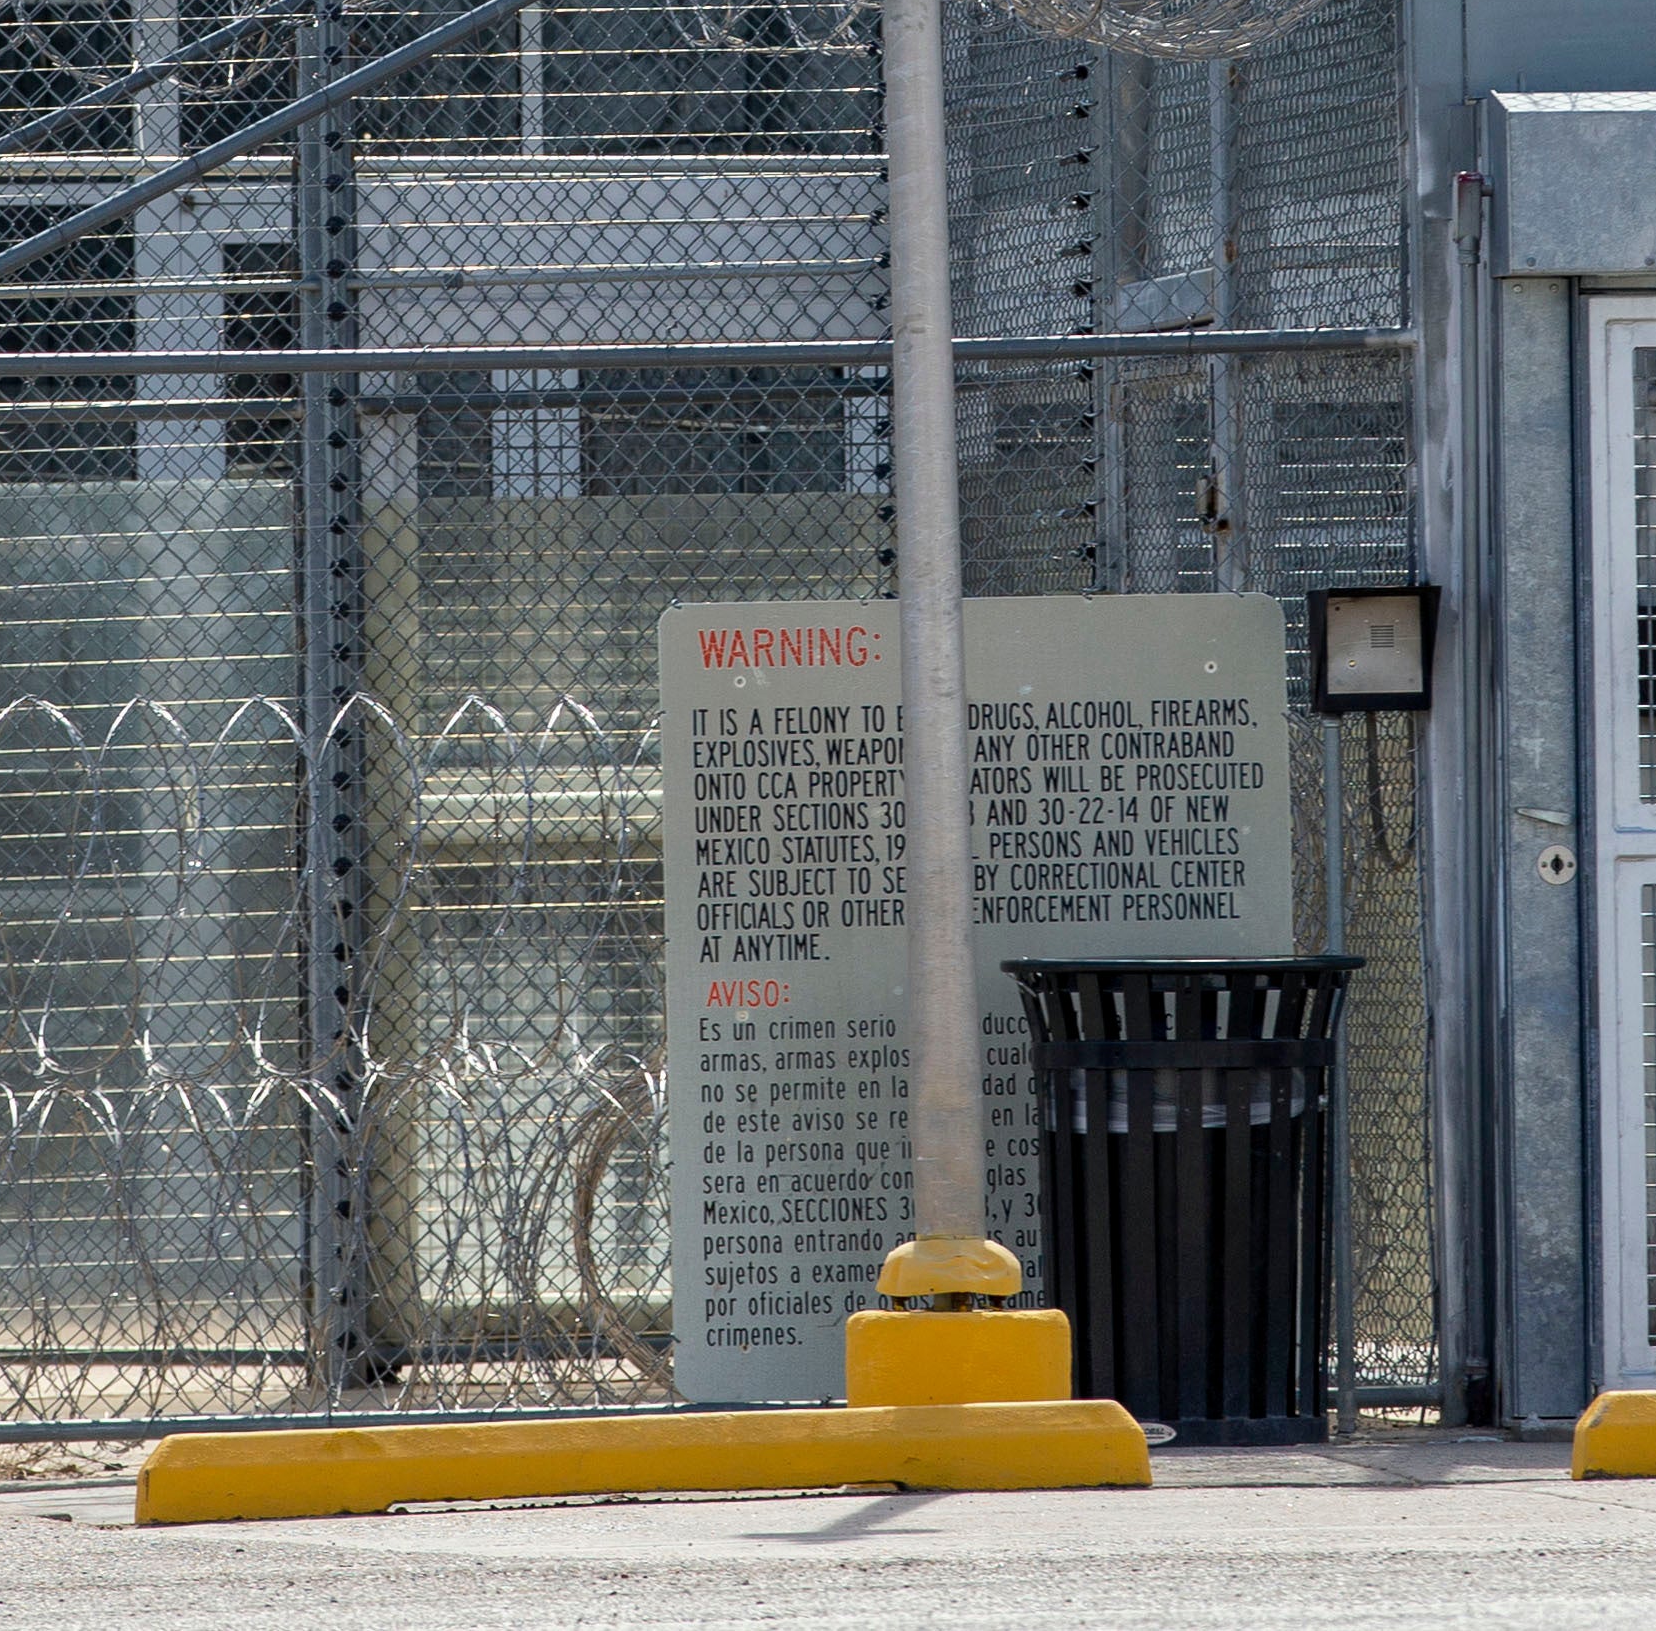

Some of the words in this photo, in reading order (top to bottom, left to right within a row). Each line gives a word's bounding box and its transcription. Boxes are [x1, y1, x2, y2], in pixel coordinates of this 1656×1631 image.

[699, 627, 881, 668] WARNING:
[693, 709, 708, 736] IT
[720, 709, 737, 736] IS
[750, 709, 763, 735] A
[775, 706, 850, 734] FELONY
[861, 705, 884, 732] TO
[968, 702, 1039, 733] DRUGS,
[1046, 701, 1143, 730] ALCOHOL,
[1152, 699, 1257, 727] FIREARMS,
[694, 739, 820, 768] EXPLOSIVES,
[826, 737, 903, 765] WEAPO
[974, 735, 1015, 762] ANY
[1027, 734, 1089, 761] OTHER
[1102, 731, 1234, 760] CONTRABAND
[695, 773, 745, 801] ONTO
[758, 772, 797, 799] CCA
[969, 766, 1031, 794] ATORS
[1043, 766, 1090, 792] WILL
[1101, 765, 1125, 792] BE
[1137, 763, 1263, 791] PROSECUTED
[695, 805, 761, 833] UNDER
[774, 802, 868, 831] SECTIONS
[987, 799, 1027, 826] AND
[1039, 797, 1138, 825] 30-22-14
[1151, 796, 1175, 823] OF
[1187, 795, 1229, 822] NEW
[696, 837, 770, 865] MEXICO
[782, 835, 880, 864] STATUTES,
[886, 834, 906, 861] 19
[990, 830, 1082, 859] PERSONS
[1093, 830, 1133, 857] AND
[1145, 827, 1239, 856] VEHICLES
[698, 871, 737, 898] ARE
[749, 868, 836, 897] SUBJECT
[847, 867, 871, 894] TO
[974, 864, 999, 891] BY
[1011, 862, 1161, 891] CORRECTIONAL
[1171, 860, 1245, 888] CENTER
[697, 902, 794, 930] OFFICIALS
[803, 901, 829, 928] OR
[842, 899, 904, 927] OTHER
[1123, 892, 1240, 921] PERSONNEL
[700, 936, 721, 962] AT
[733, 934, 829, 962] ANYTIME.
[708, 981, 790, 1007] AVISO:
[700, 1018, 720, 1041] Es
[733, 1023, 755, 1041] un
[769, 1016, 835, 1040] crimen
[847, 1014, 896, 1038] serio
[701, 1054, 766, 1072] armas,
[776, 1051, 835, 1070] armas
[848, 1045, 910, 1074] explos
[702, 1085, 723, 1102] no
[736, 1084, 757, 1102] se
[771, 1076, 846, 1106] permite
[858, 1081, 880, 1099] en
[892, 1075, 908, 1098] la
[704, 1111, 725, 1133] de
[738, 1110, 780, 1132] este
[793, 1107, 844, 1131] aviso
[856, 1112, 878, 1130] se
[991, 1107, 1013, 1127] en
[704, 1141, 725, 1163] de
[738, 1141, 753, 1162] la
[766, 1142, 844, 1167] persona
[856, 1142, 890, 1167] que
[703, 1176, 744, 1194] sera
[757, 1175, 781, 1193] en
[791, 1168, 871, 1194] acuerdo
[881, 1171, 914, 1190] con
[986, 1163, 1027, 1194] glas
[704, 1200, 774, 1224] Mexico,
[780, 1197, 887, 1223] SECCIONES
[704, 1235, 782, 1260] persona
[794, 1228, 883, 1253] entrando
[706, 1261, 778, 1293] sujetos
[791, 1266, 800, 1283] a
[706, 1298, 736, 1324] por
[749, 1291, 832, 1315] oficiales
[844, 1290, 868, 1313] de
[707, 1323, 802, 1347] crimenes.
